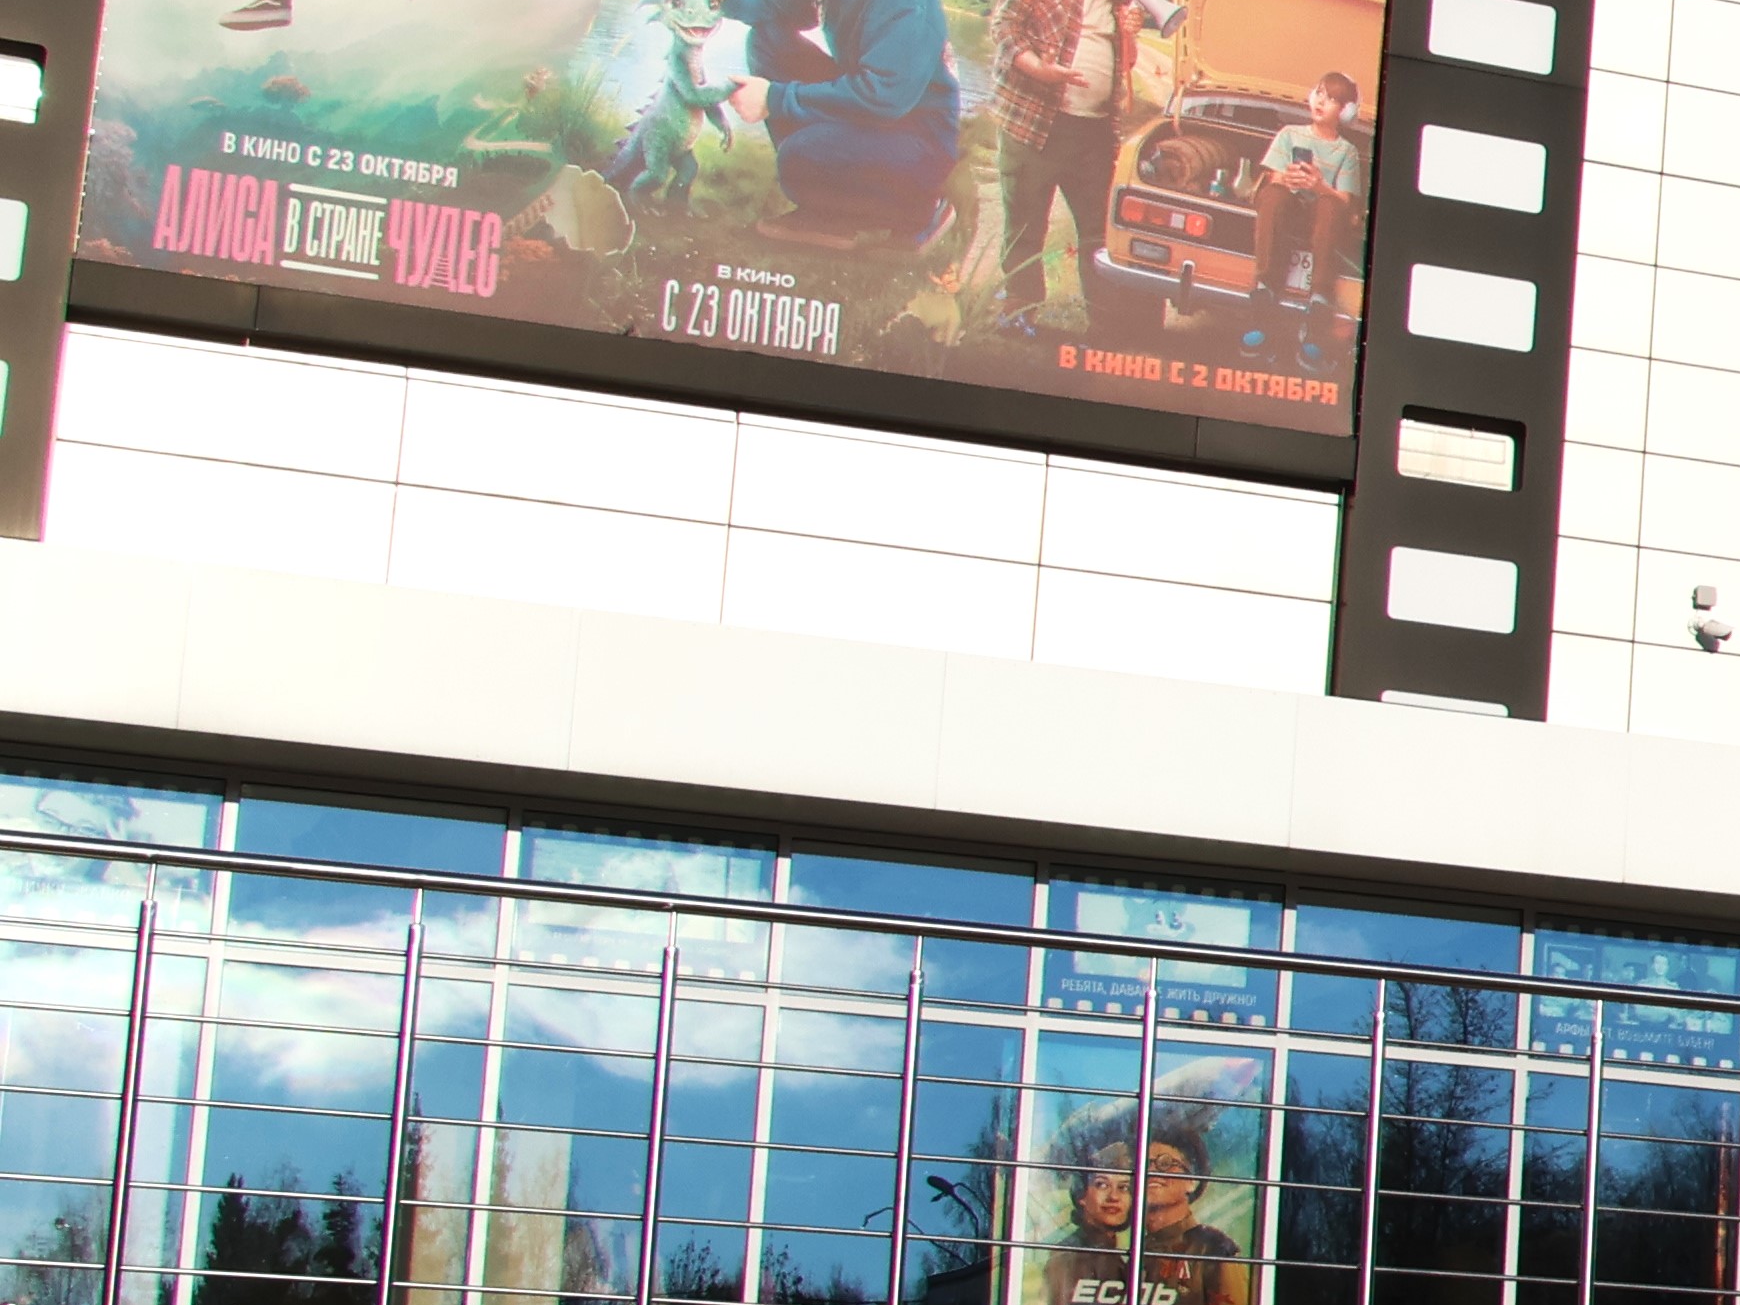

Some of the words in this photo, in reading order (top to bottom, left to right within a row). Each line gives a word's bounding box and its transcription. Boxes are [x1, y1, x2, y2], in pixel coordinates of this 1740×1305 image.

[221, 132, 238, 154] В
[241, 134, 301, 165] КИНО
[306, 148, 322, 167] С
[326, 148, 354, 172] 23
[359, 153, 459, 188] ОКТЯБРЯ
[153, 164, 279, 266] АЛИСА
[283, 197, 301, 254] В
[305, 200, 386, 265] СТРАНЕ
[387, 198, 502, 298] ЧУДЕС
[717, 264, 731, 280] В
[736, 268, 795, 288] КИНО
[661, 279, 680, 332] С
[686, 283, 720, 338] 23
[726, 288, 840, 355] ОКТЯБРЯ
[1059, 345, 1077, 369] В
[1085, 349, 1162, 381] КИНО
[1169, 361, 1185, 384] С
[1192, 364, 1208, 388] 2
[1214, 367, 1338, 406] ОКТЯБРЯ
[1061, 978, 1107, 995] РЕБЯТА,
[1166, 988, 1200, 1002] ЖИТЬ
[1203, 990, 1257, 1007] ДРУЖНО!
